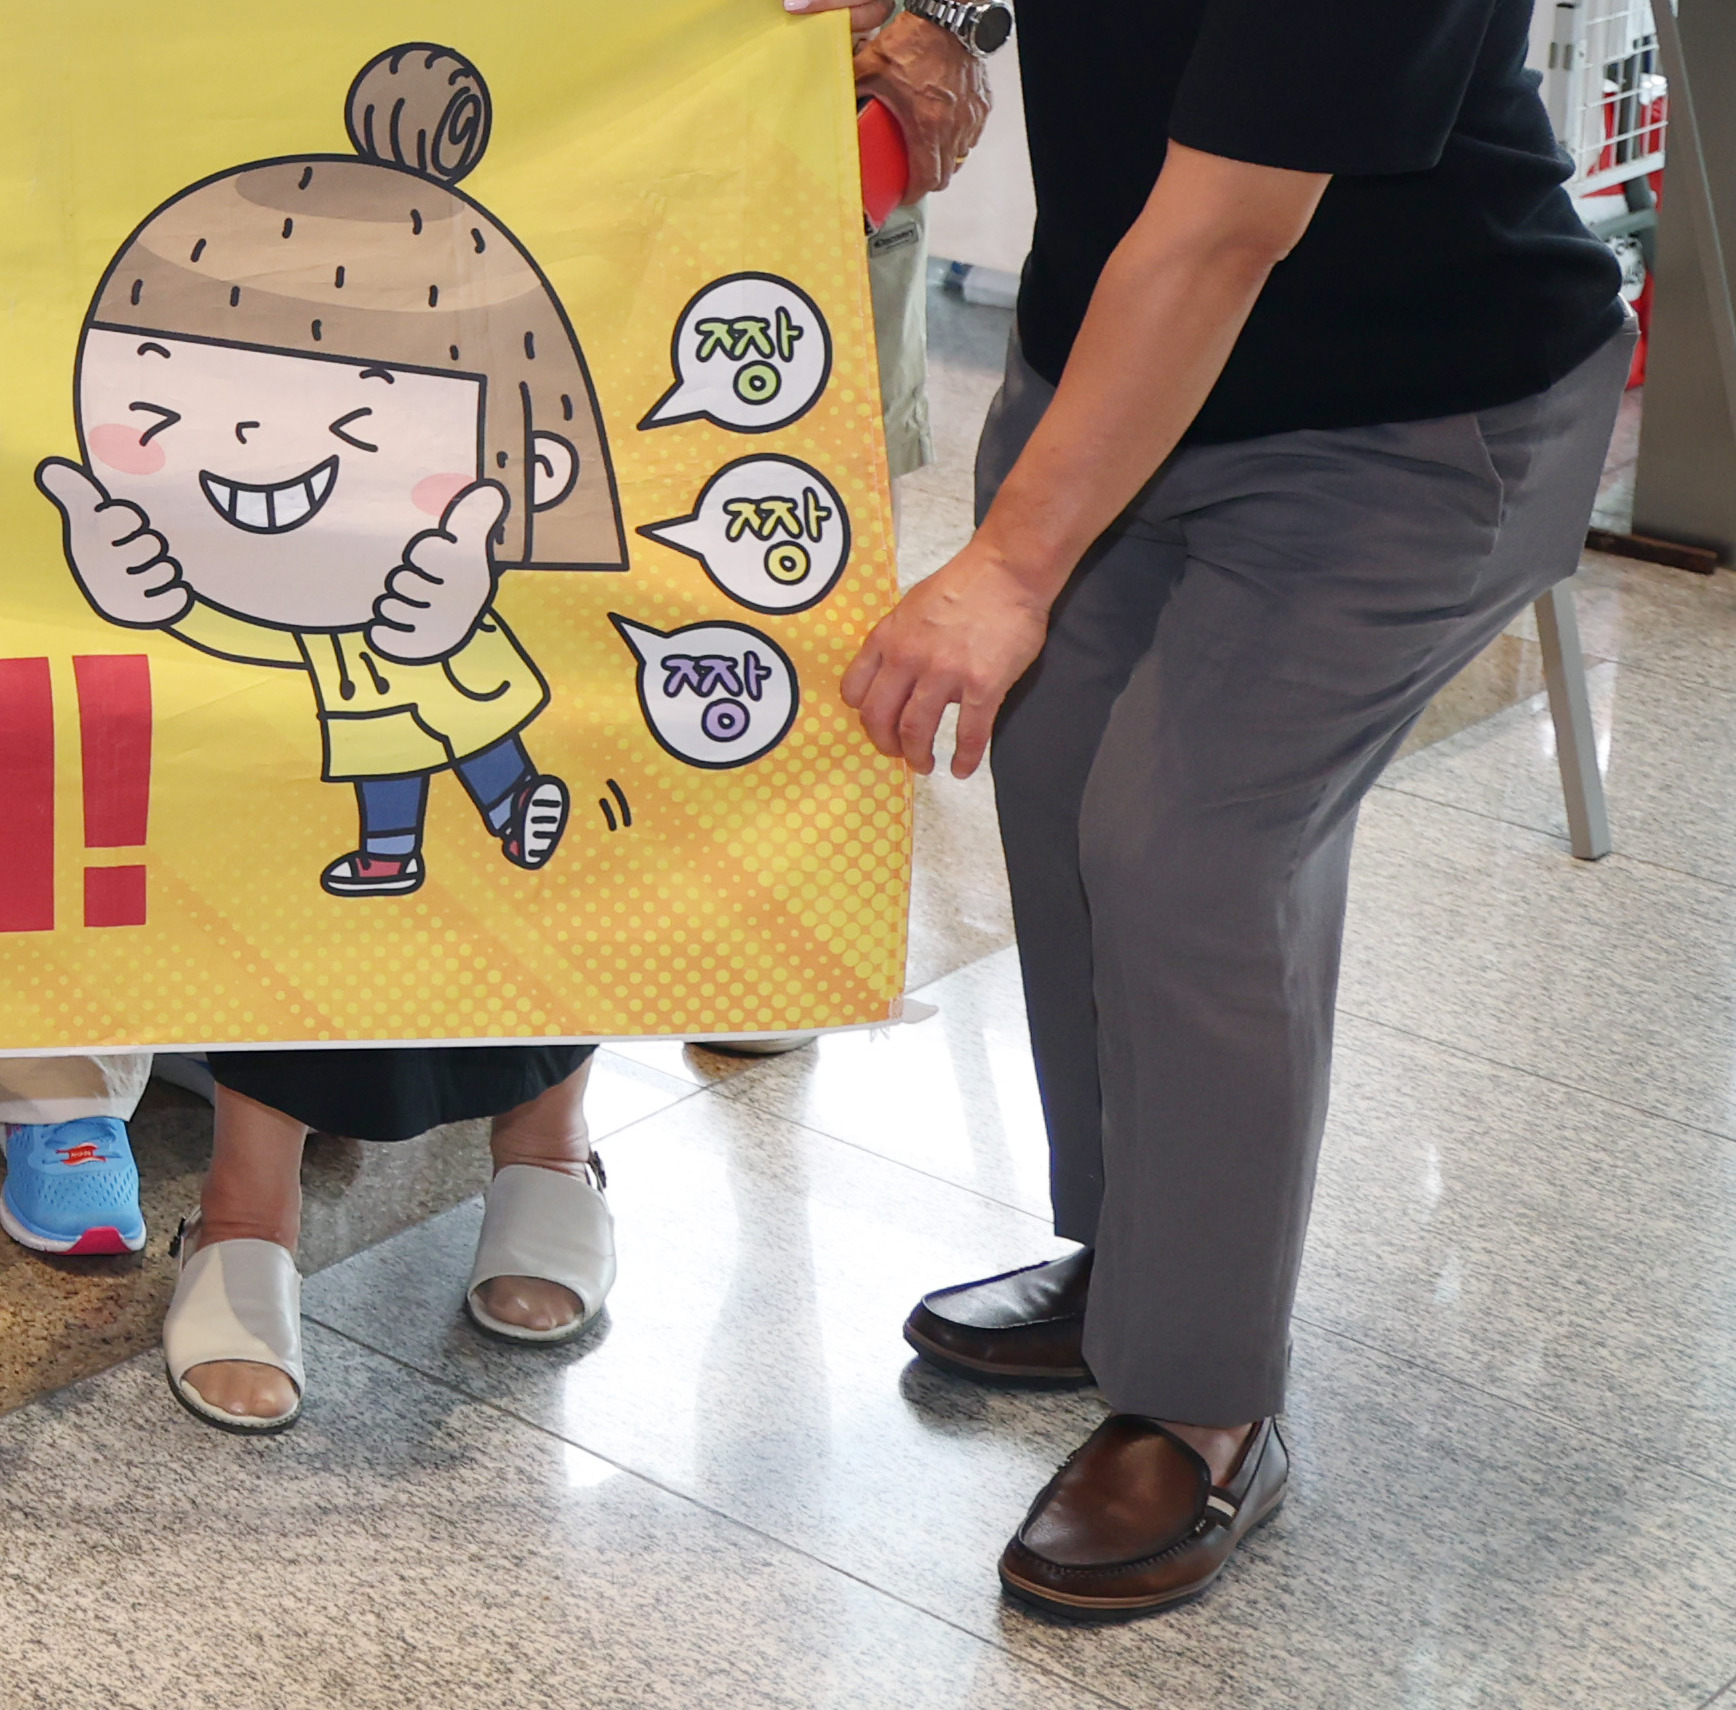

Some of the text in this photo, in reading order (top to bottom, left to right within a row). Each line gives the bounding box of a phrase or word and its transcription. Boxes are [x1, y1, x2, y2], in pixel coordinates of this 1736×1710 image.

[695, 306, 804, 405] 짱
[722, 487, 832, 585] 짱
[662, 651, 772, 742] 짱
